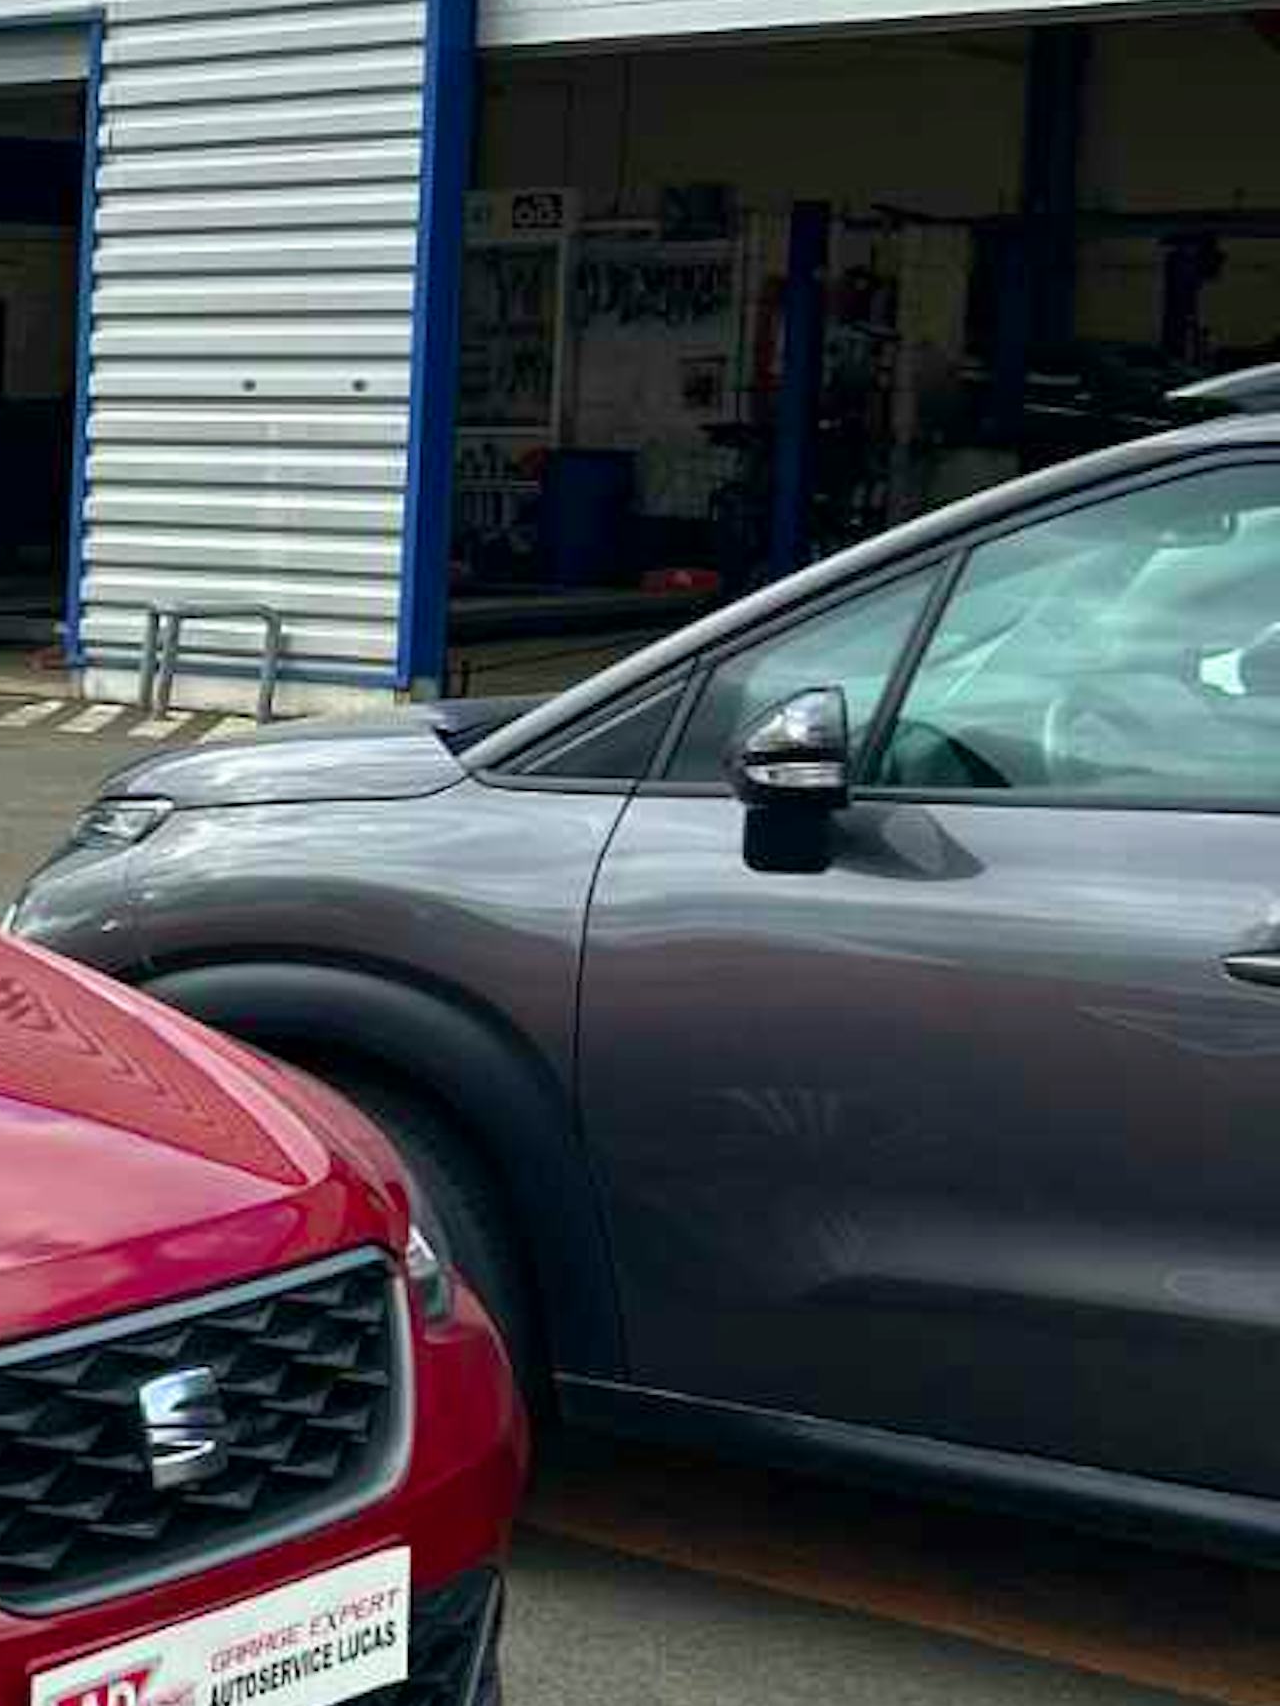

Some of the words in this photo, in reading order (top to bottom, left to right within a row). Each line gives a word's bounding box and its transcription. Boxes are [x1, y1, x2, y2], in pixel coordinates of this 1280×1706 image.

[210, 1622, 305, 1673] GARAGE
[309, 1587, 401, 1636] EXPERT
[338, 1620, 397, 1664] LUCAS
